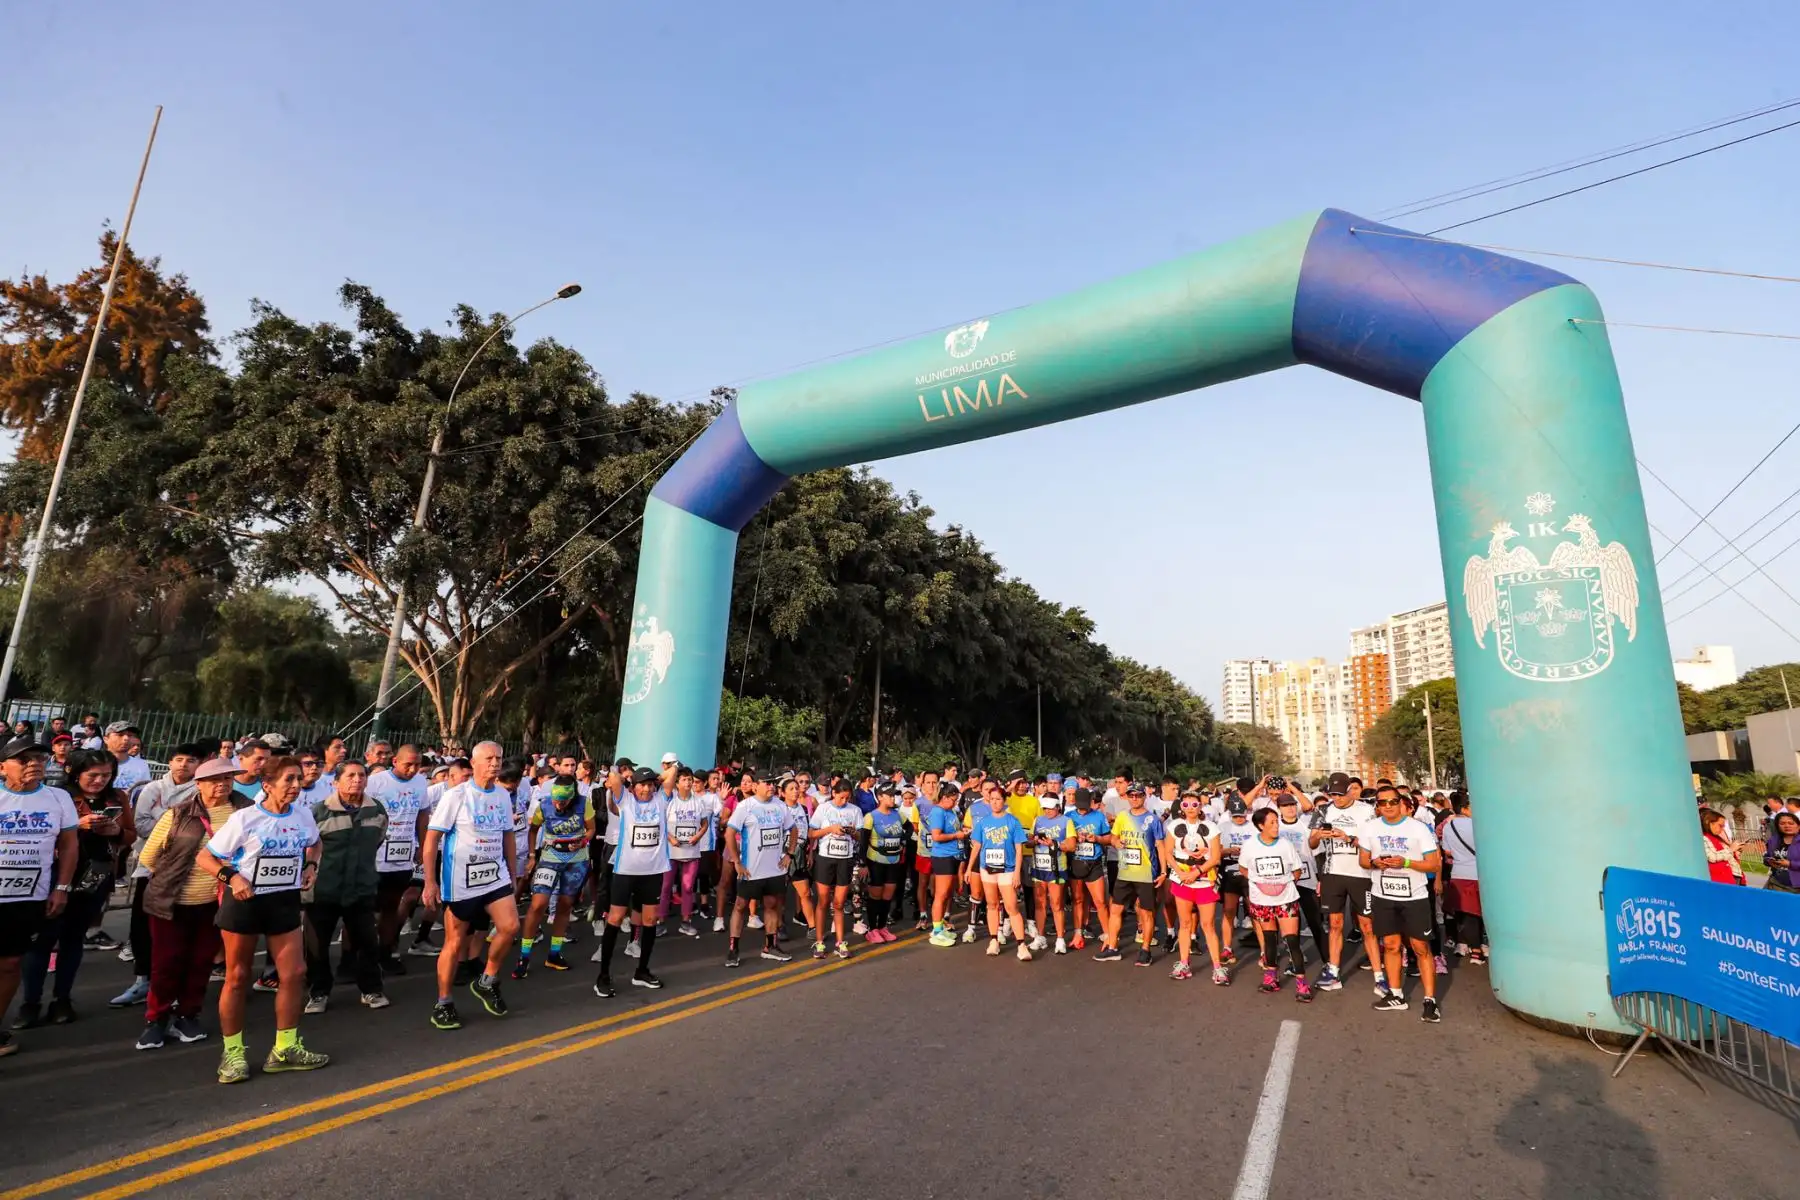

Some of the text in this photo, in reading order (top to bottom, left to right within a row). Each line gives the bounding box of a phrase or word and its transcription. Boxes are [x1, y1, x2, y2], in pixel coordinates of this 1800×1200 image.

[915, 350, 1017, 385] MUNICIPALIDAD DE
[918, 372, 1029, 422] LIMA
[1528, 522, 1558, 538] IK
[1498, 570, 1551, 586] HOC
[636, 832, 657, 840] 3319
[389, 848, 410, 856] 2407
[260, 865, 294, 877] 3585
[1383, 882, 1407, 891] 3638
[1633, 908, 1681, 939] 1815
[1701, 926, 1787, 963] SALUDABLE
[1770, 926, 1800, 947] VIV
[1617, 940, 1687, 955] HABLA FRANCO
[1718, 960, 1800, 998] #PonteEnM
